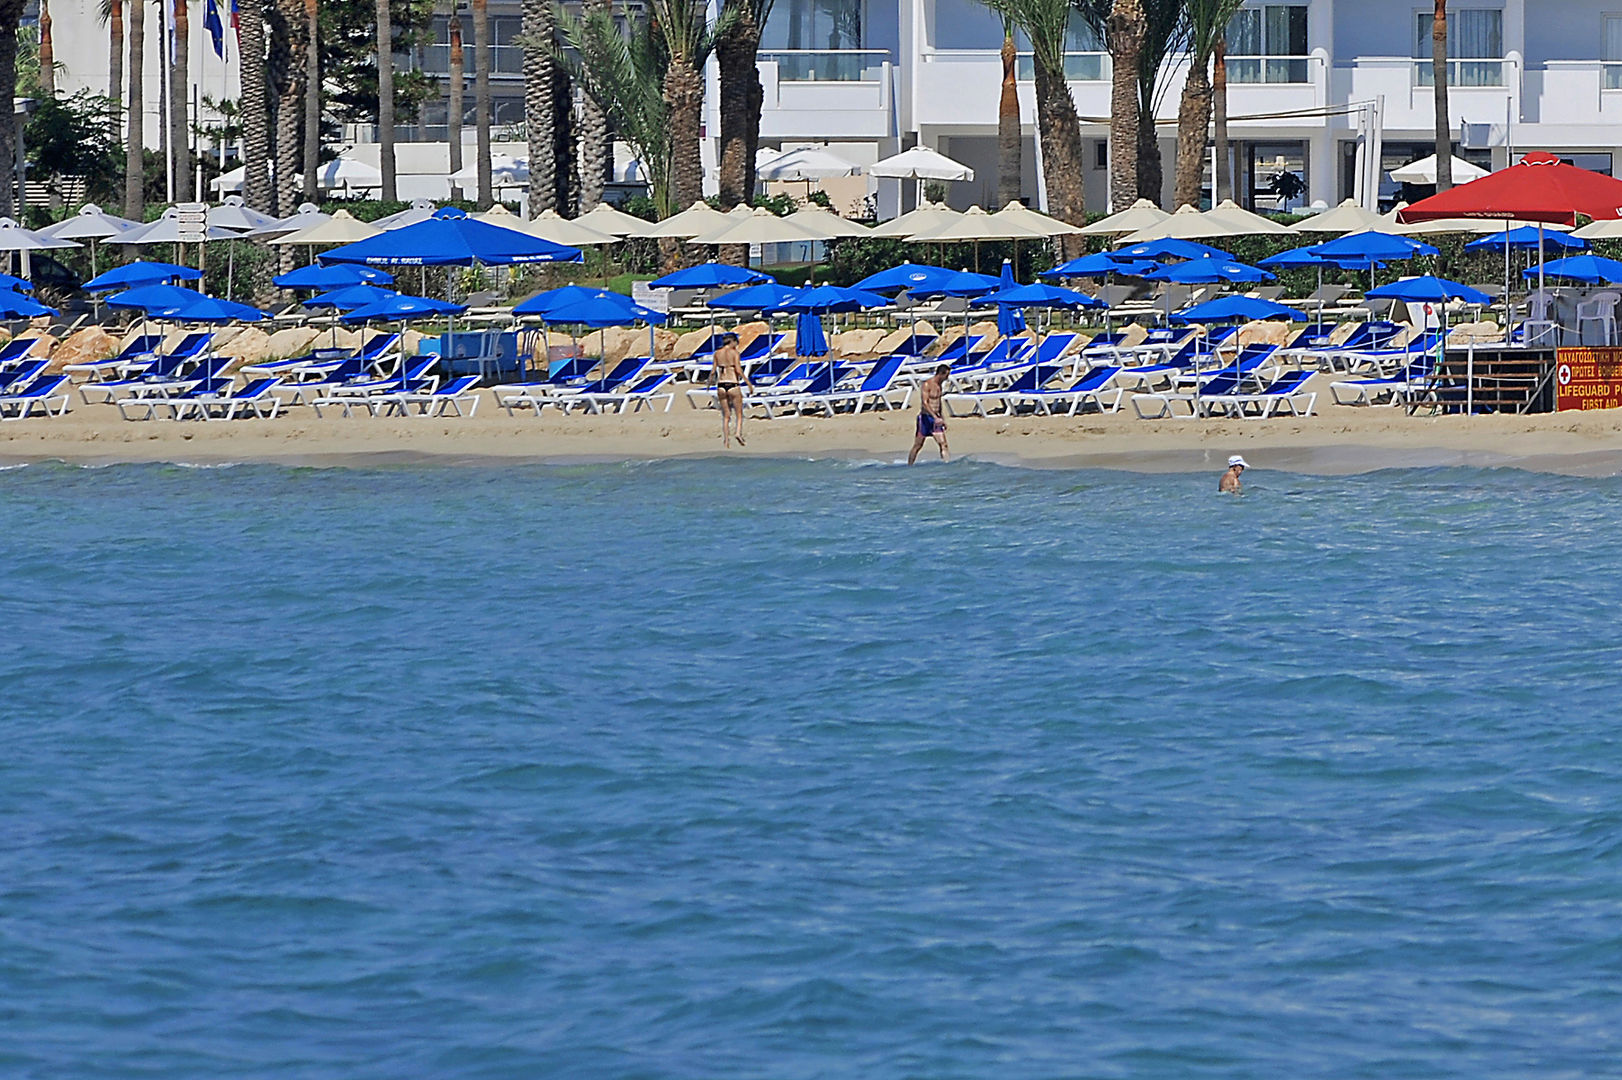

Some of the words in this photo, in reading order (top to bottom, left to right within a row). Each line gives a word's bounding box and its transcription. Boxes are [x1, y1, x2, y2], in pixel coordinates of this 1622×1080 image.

[1559, 385, 1610, 397] LIFEGUARD
[1582, 399, 1604, 410] FIRST
[1605, 399, 1618, 409] AID
